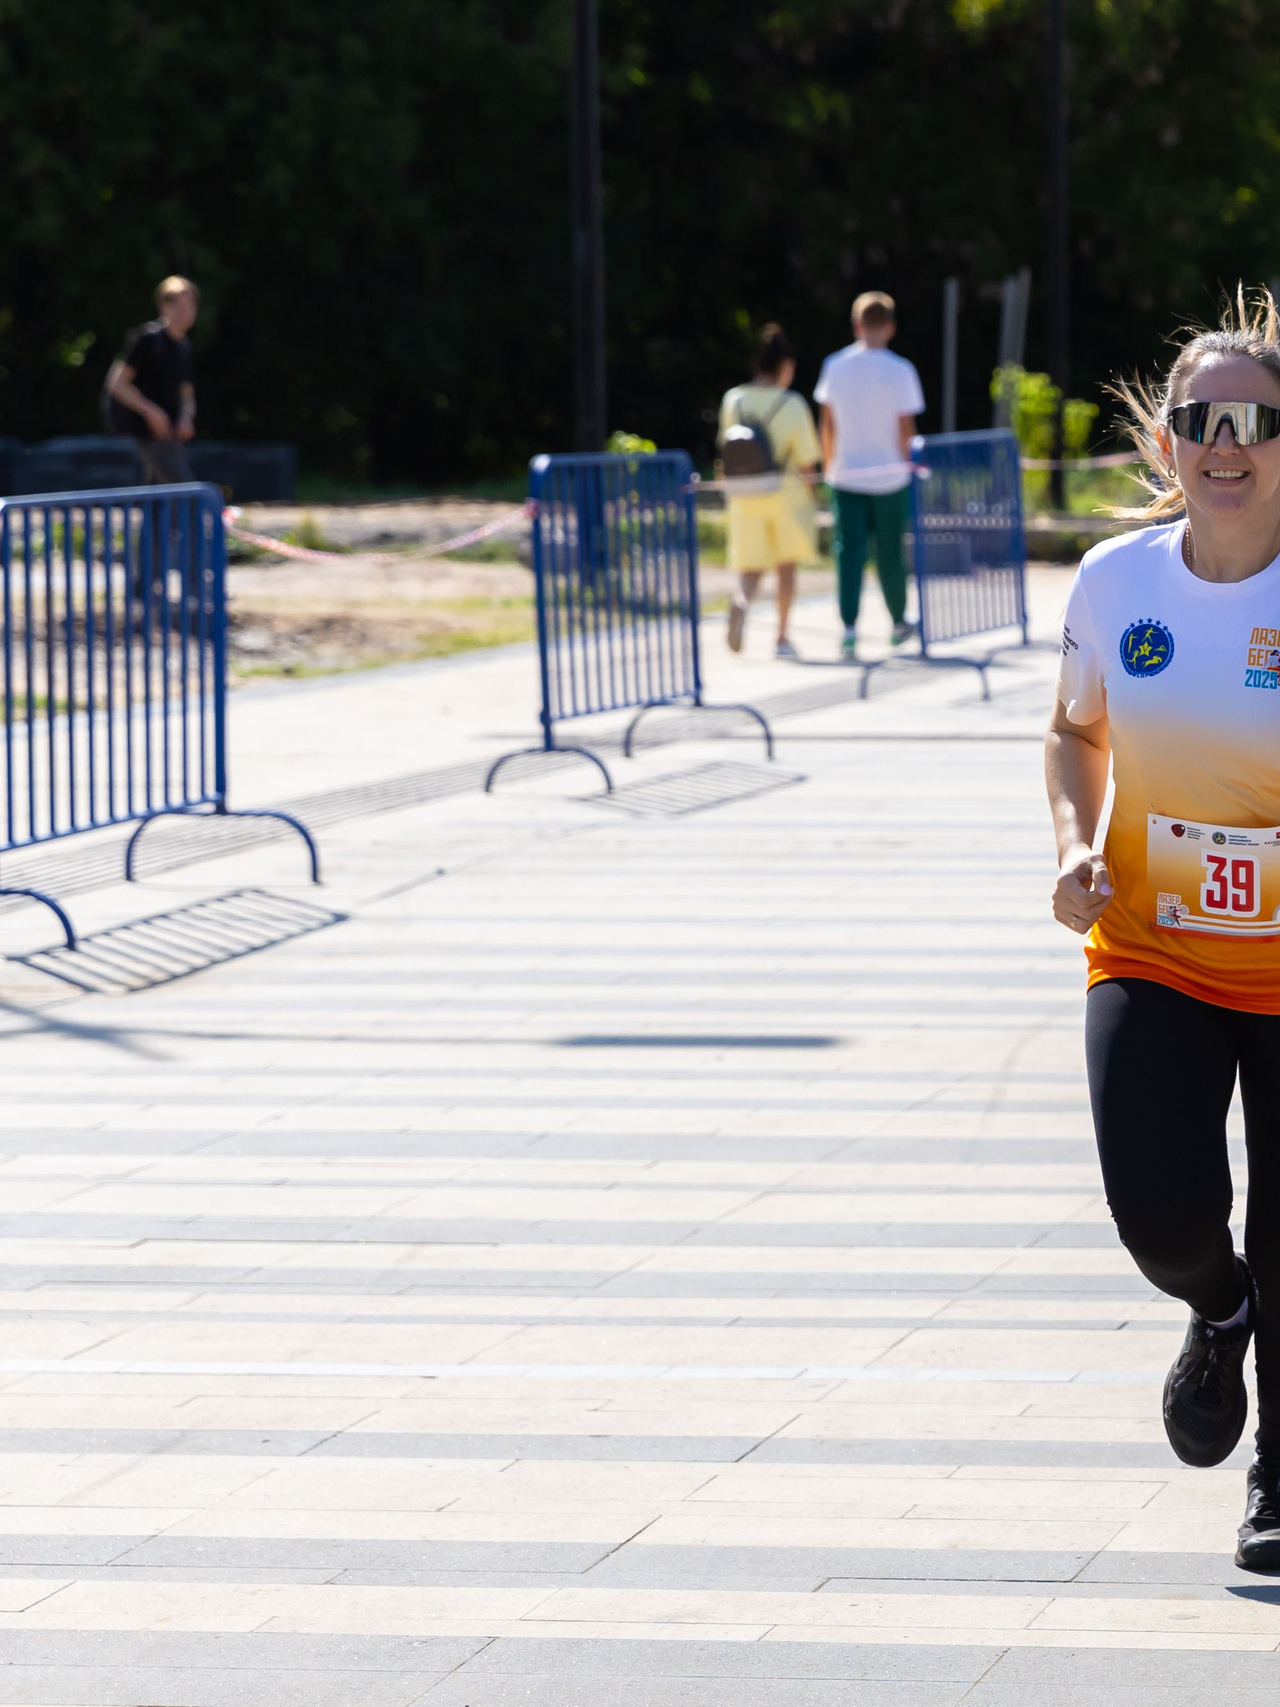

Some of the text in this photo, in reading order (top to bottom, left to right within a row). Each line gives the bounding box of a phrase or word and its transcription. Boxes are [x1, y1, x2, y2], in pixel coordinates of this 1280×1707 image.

[1244, 669, 1278, 689] 2025
[1206, 854, 1254, 912] 39
[1157, 914, 1175, 927] 2025
